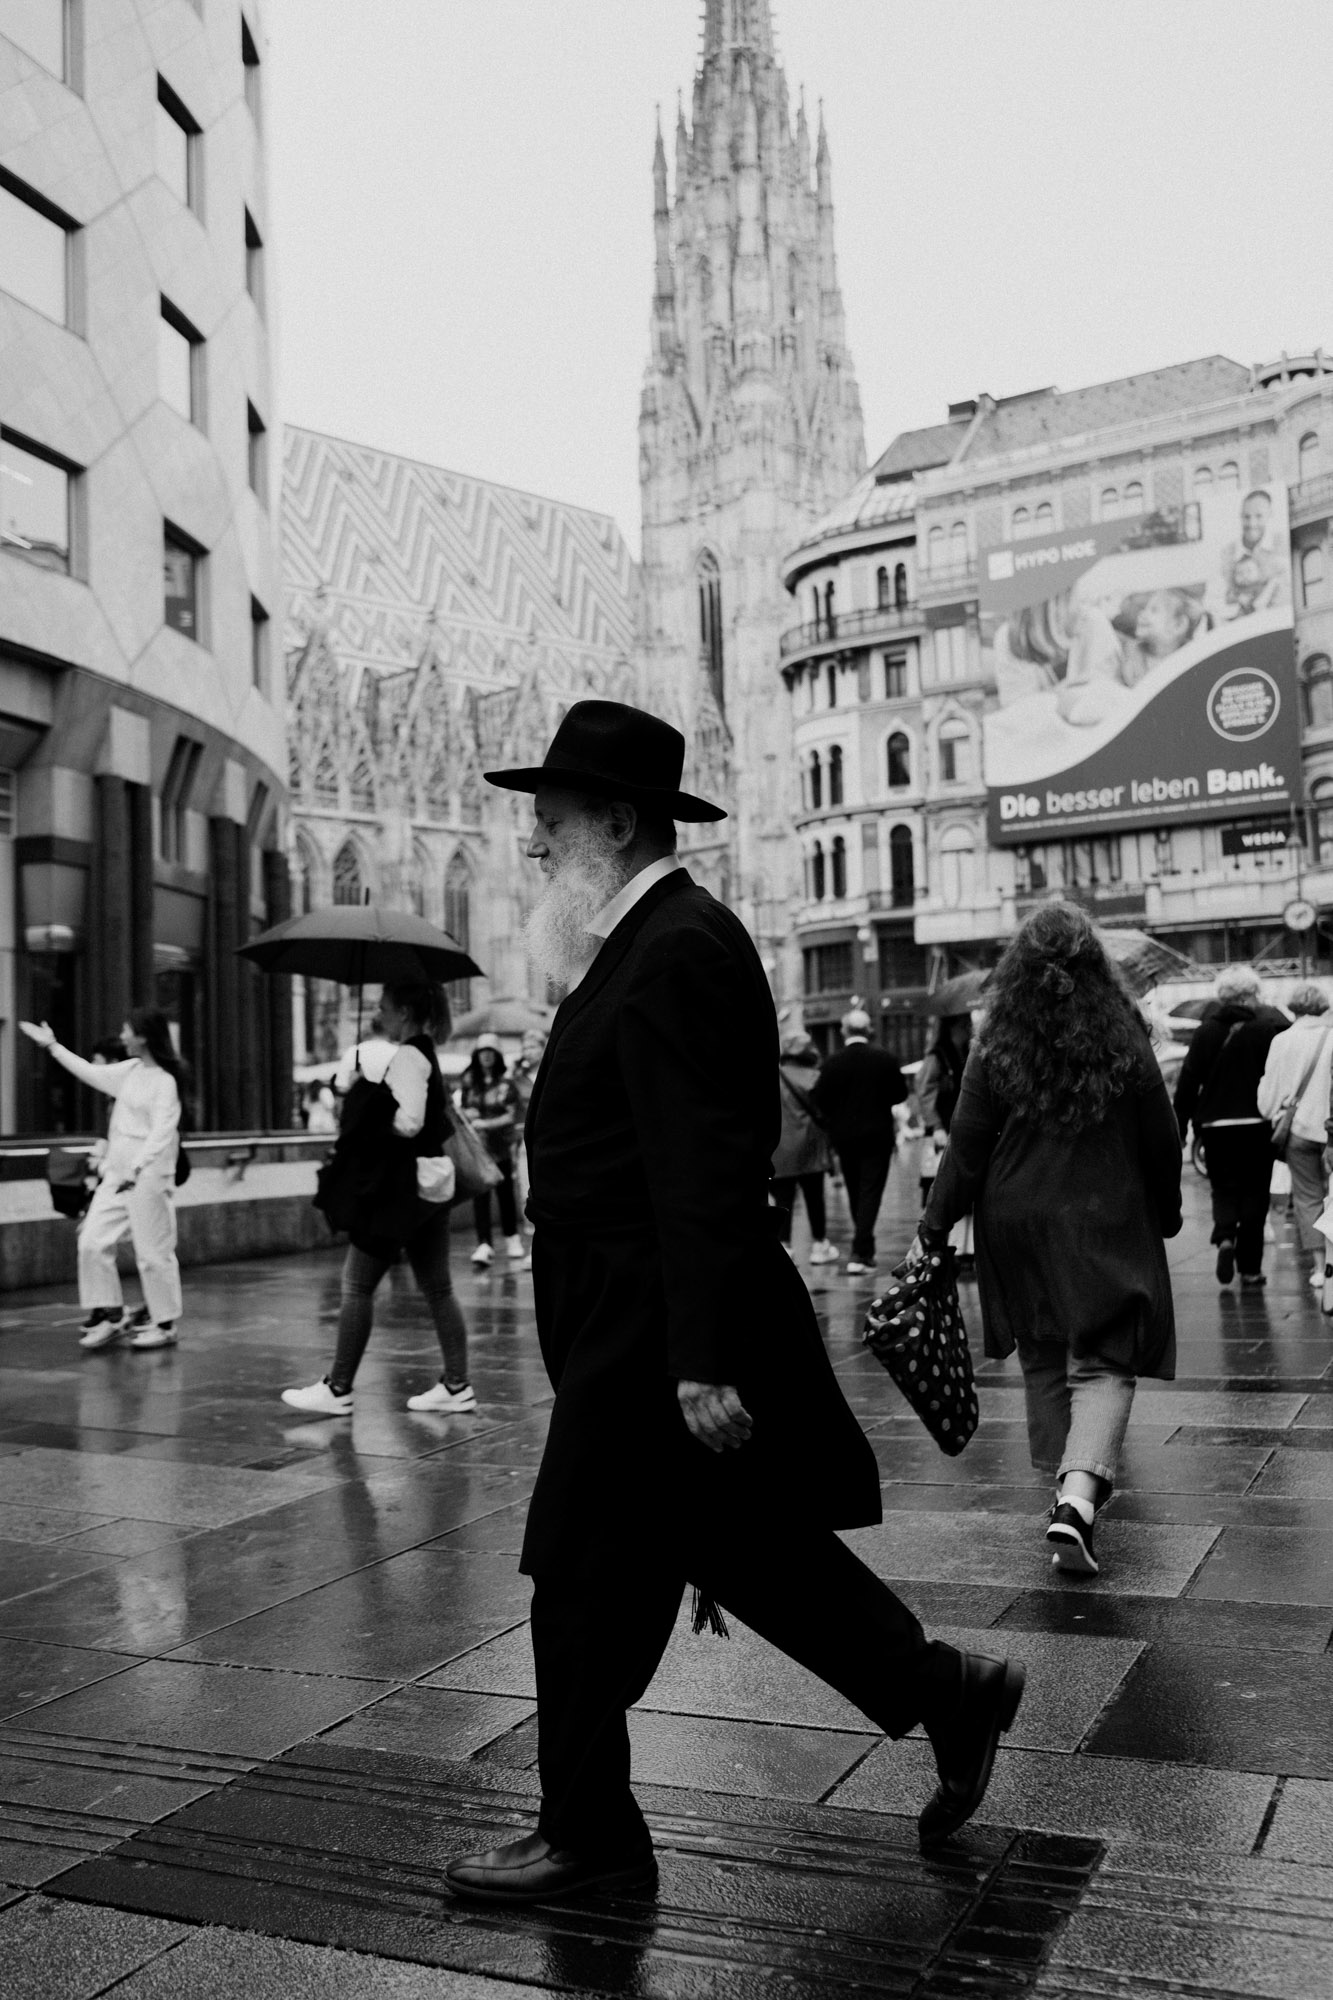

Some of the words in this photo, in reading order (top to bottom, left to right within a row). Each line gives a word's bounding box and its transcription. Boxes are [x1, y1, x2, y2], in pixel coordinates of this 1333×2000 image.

[1000, 793, 1040, 819] Die
[1046, 785, 1125, 814] besser
[1131, 779, 1199, 804] leben
[1207, 762, 1285, 795] Bank.
